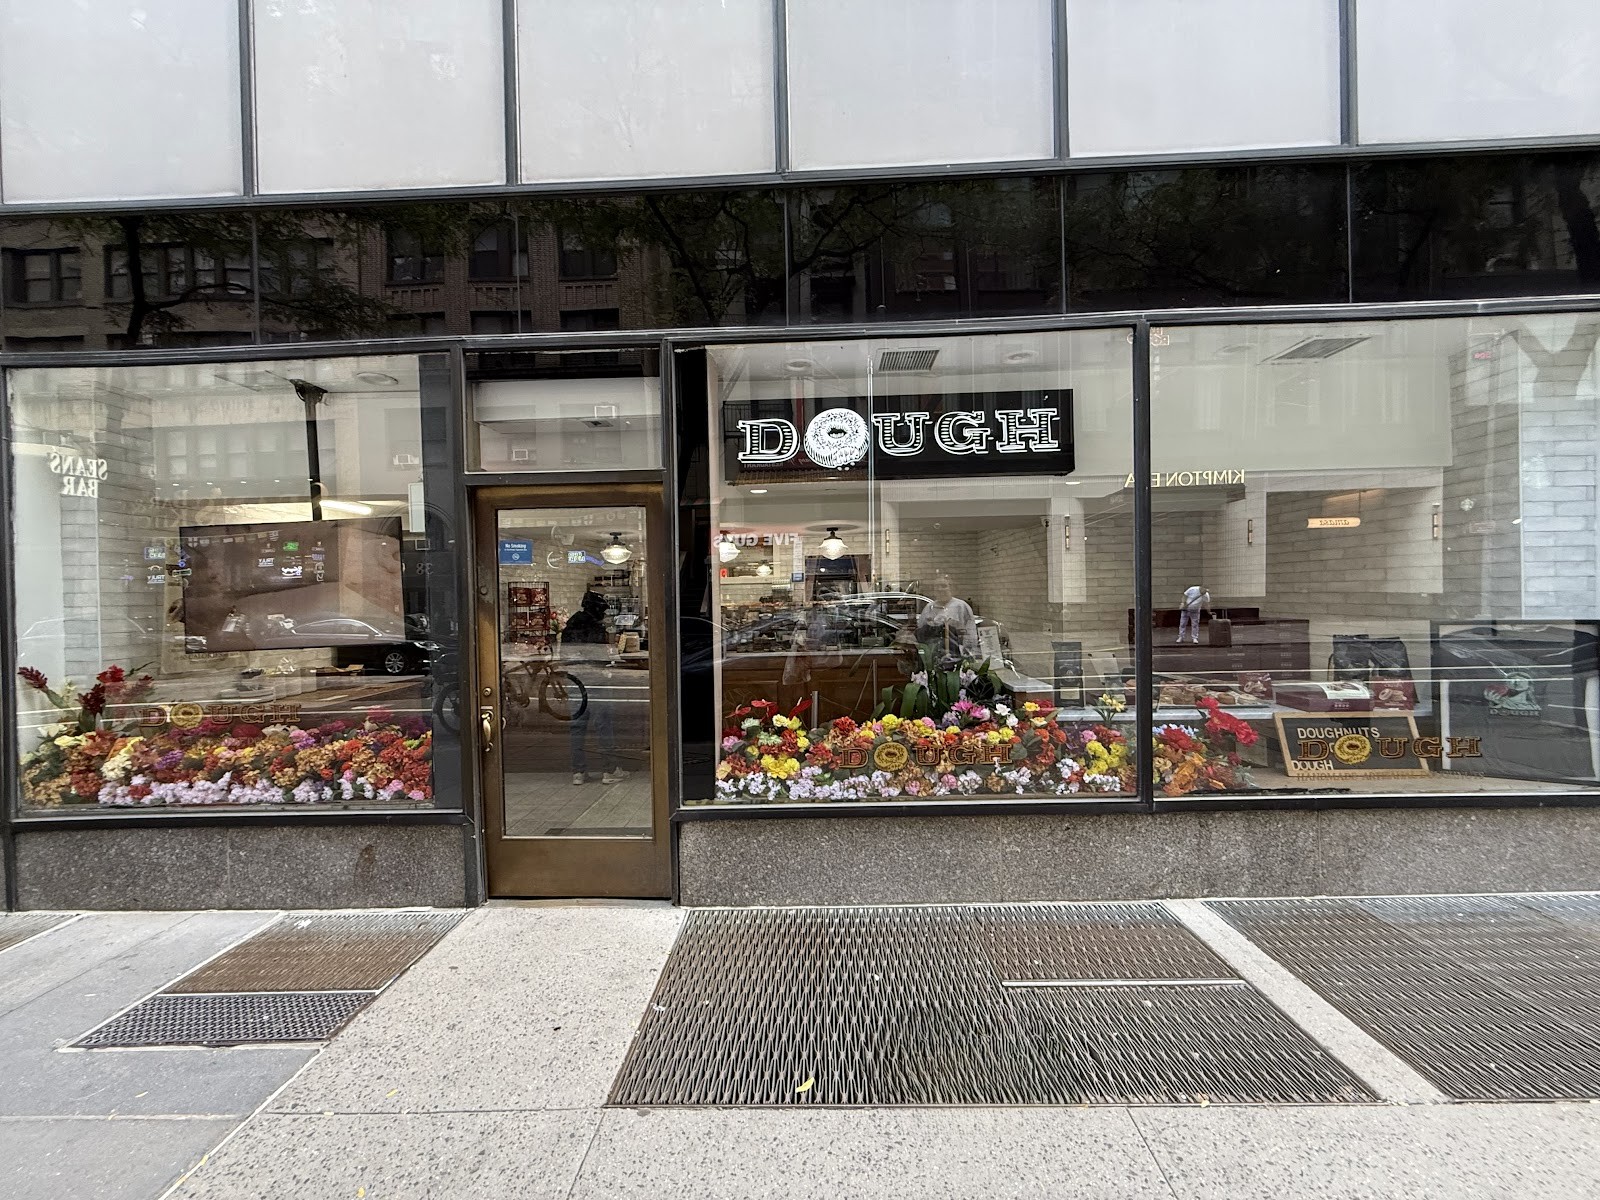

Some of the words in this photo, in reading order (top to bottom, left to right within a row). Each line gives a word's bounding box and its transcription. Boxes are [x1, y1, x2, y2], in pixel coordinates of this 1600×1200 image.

[737, 407, 1062, 470] DOUGH
[839, 742, 1013, 771] DOUGH
[1298, 735, 1482, 765] DOUGH
[1292, 760, 1334, 771] DOUGH
